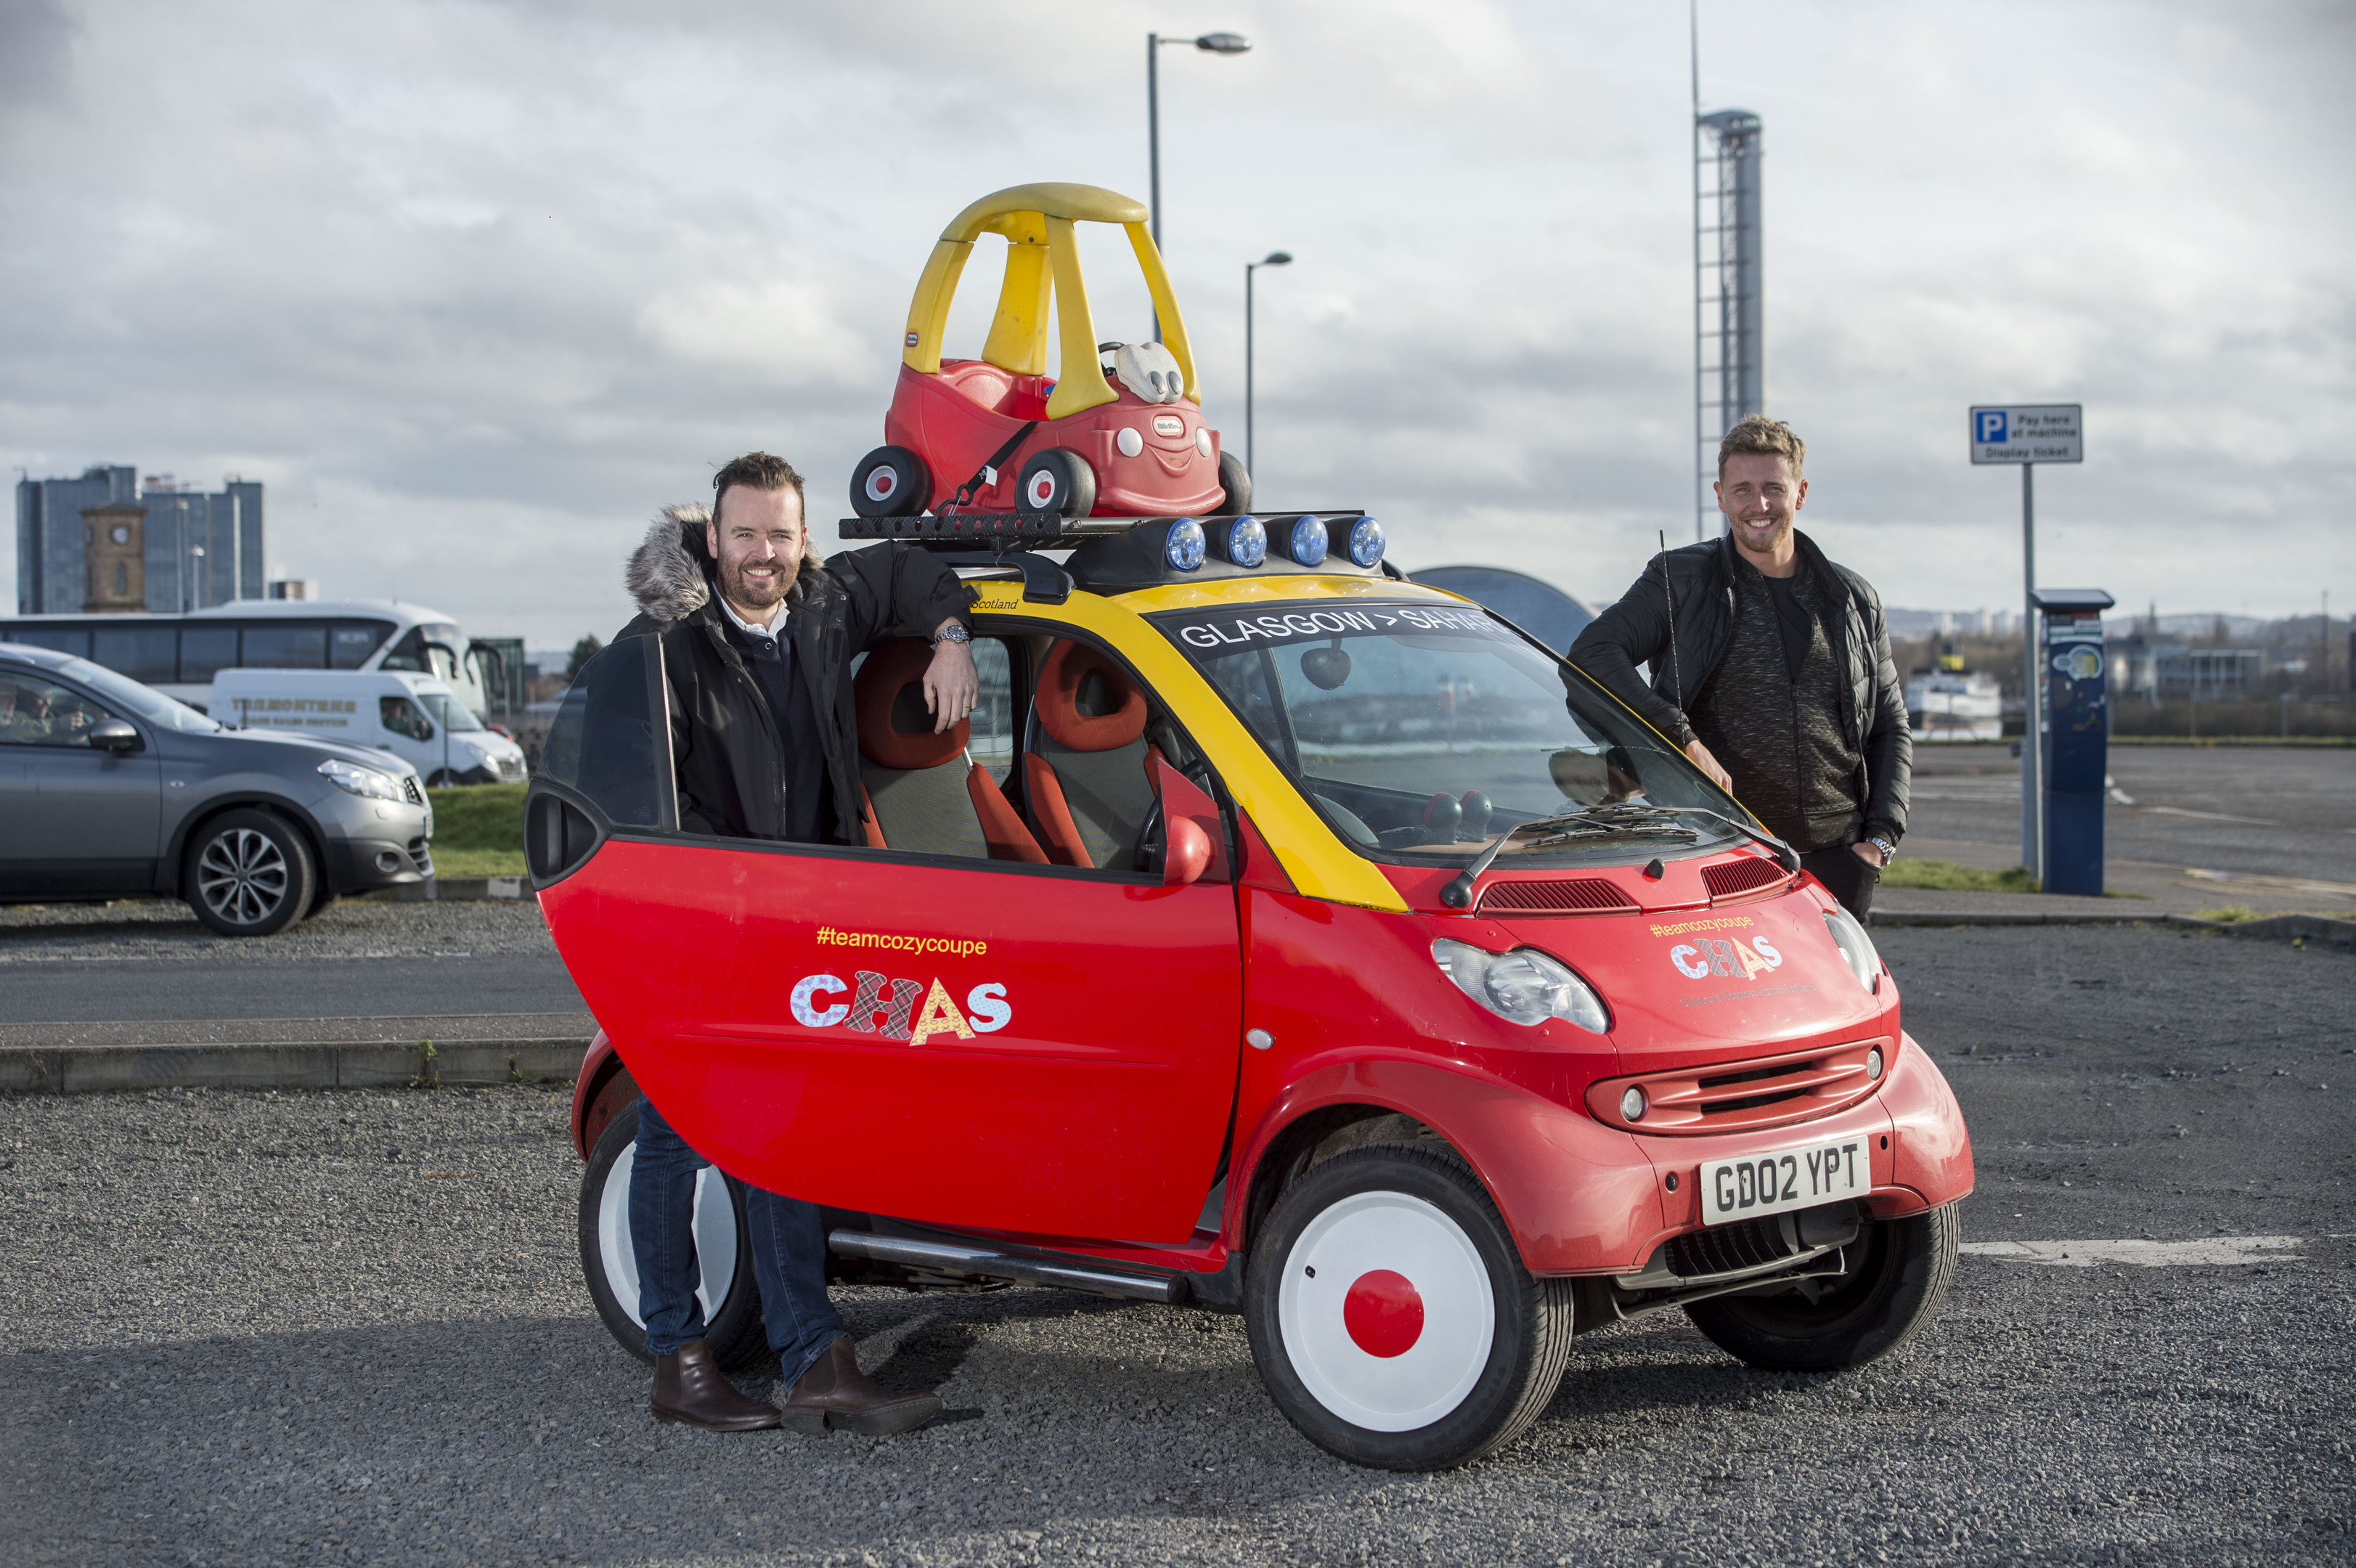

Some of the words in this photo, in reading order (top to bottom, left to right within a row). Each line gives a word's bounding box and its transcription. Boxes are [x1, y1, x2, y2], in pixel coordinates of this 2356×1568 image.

[1982, 414, 2003, 441] P
[2011, 429, 2023, 438] at
[2026, 428, 2076, 438] machine
[2018, 415, 2039, 425] Pay
[2043, 415, 2070, 424] here
[1986, 446, 2029, 459] Display
[2033, 446, 2068, 457] ticket
[1181, 611, 1377, 648] GLASGOW
[817, 926, 987, 957] #teamcozycoupe
[1650, 916, 1754, 938] #teamcozycoupe
[1670, 935, 1782, 981] CHAS
[790, 971, 1011, 1047] CHAS
[1715, 1155, 1798, 1212] GD02
[1806, 1143, 1858, 1196] YPT
